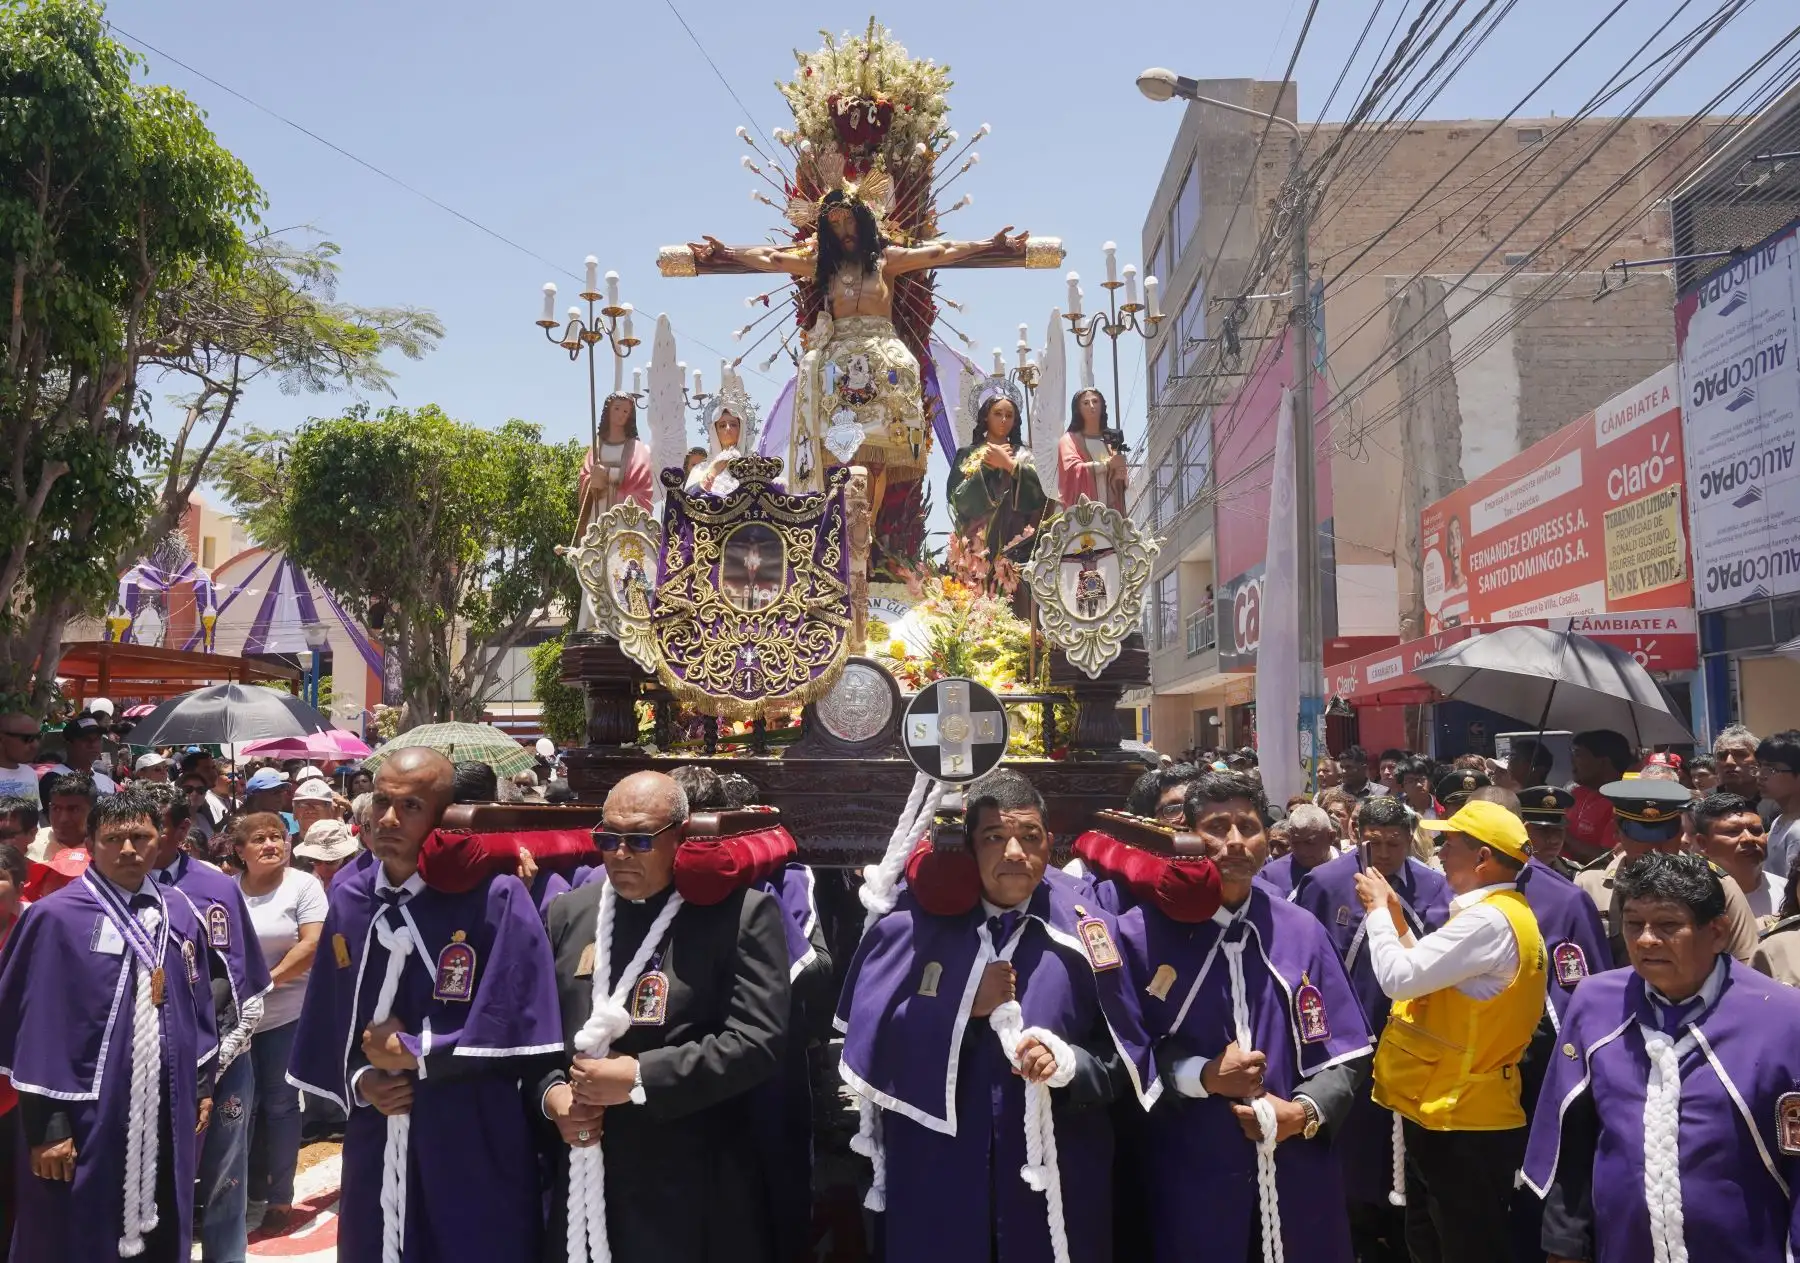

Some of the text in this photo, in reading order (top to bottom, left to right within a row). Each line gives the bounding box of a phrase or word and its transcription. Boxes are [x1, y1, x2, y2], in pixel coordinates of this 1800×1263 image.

[1698, 241, 1778, 309] ALUCOPA
[1693, 338, 1788, 407] ALUCOPAC
[1601, 386, 1670, 434] CÁMBIATE A
[1607, 455, 1664, 501] Claro
[1700, 441, 1796, 500] ALUCOPAC
[1469, 508, 1589, 573] FERNANDEZ EXPRESS S.A.
[1615, 515, 1664, 541] PROPIEDAD DE
[1638, 527, 1670, 548] GUSTAVO
[1478, 538, 1589, 594] SANTO DOMINGO S.A.
[1636, 538, 1677, 564] RODRIGUEZ
[1707, 548, 1800, 593] ALUCOPAC
[1626, 569, 1639, 592] SE
[1639, 556, 1675, 588] VENDE
[1571, 617, 1678, 631] CÁMBIATE A
[744, 671, 753, 692] 1
[1336, 675, 1355, 695] Claro
